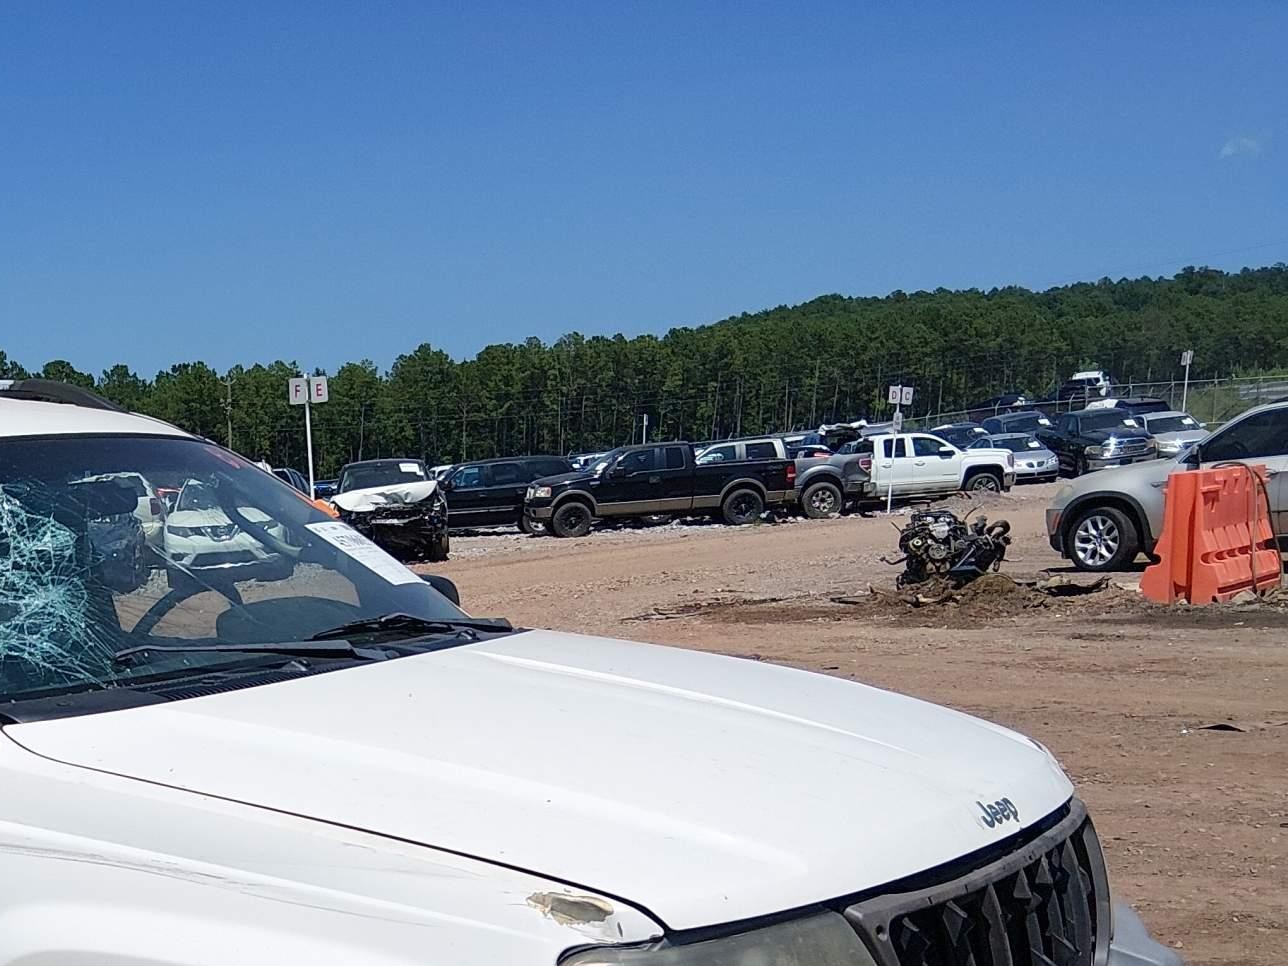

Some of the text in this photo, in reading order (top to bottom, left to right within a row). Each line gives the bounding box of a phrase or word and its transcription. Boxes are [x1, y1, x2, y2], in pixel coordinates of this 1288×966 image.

[294, 384, 301, 398] F
[316, 383, 323, 397] E
[905, 391, 911, 400] C
[976, 797, 1020, 828] Jeep
